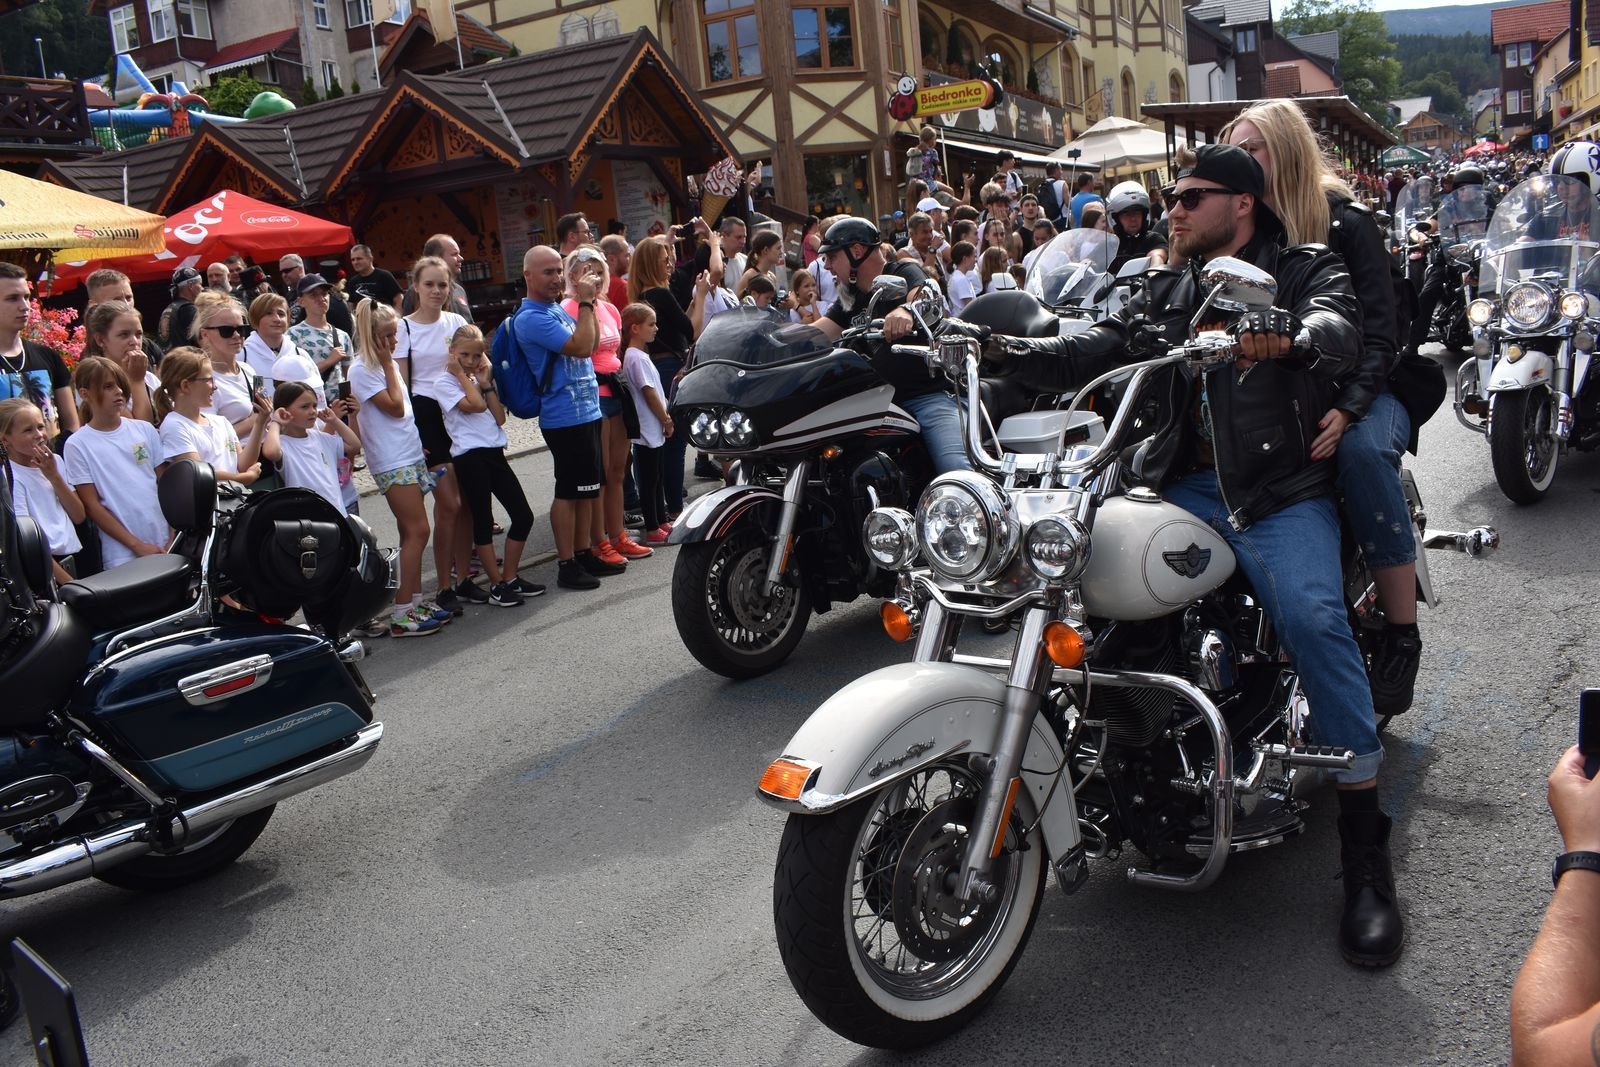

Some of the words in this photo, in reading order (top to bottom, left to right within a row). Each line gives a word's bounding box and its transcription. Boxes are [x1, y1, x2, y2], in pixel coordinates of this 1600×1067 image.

[920, 87, 982, 104] Biedronka
[0, 231, 48, 241] vijany
[74, 224, 139, 240] Svijany
